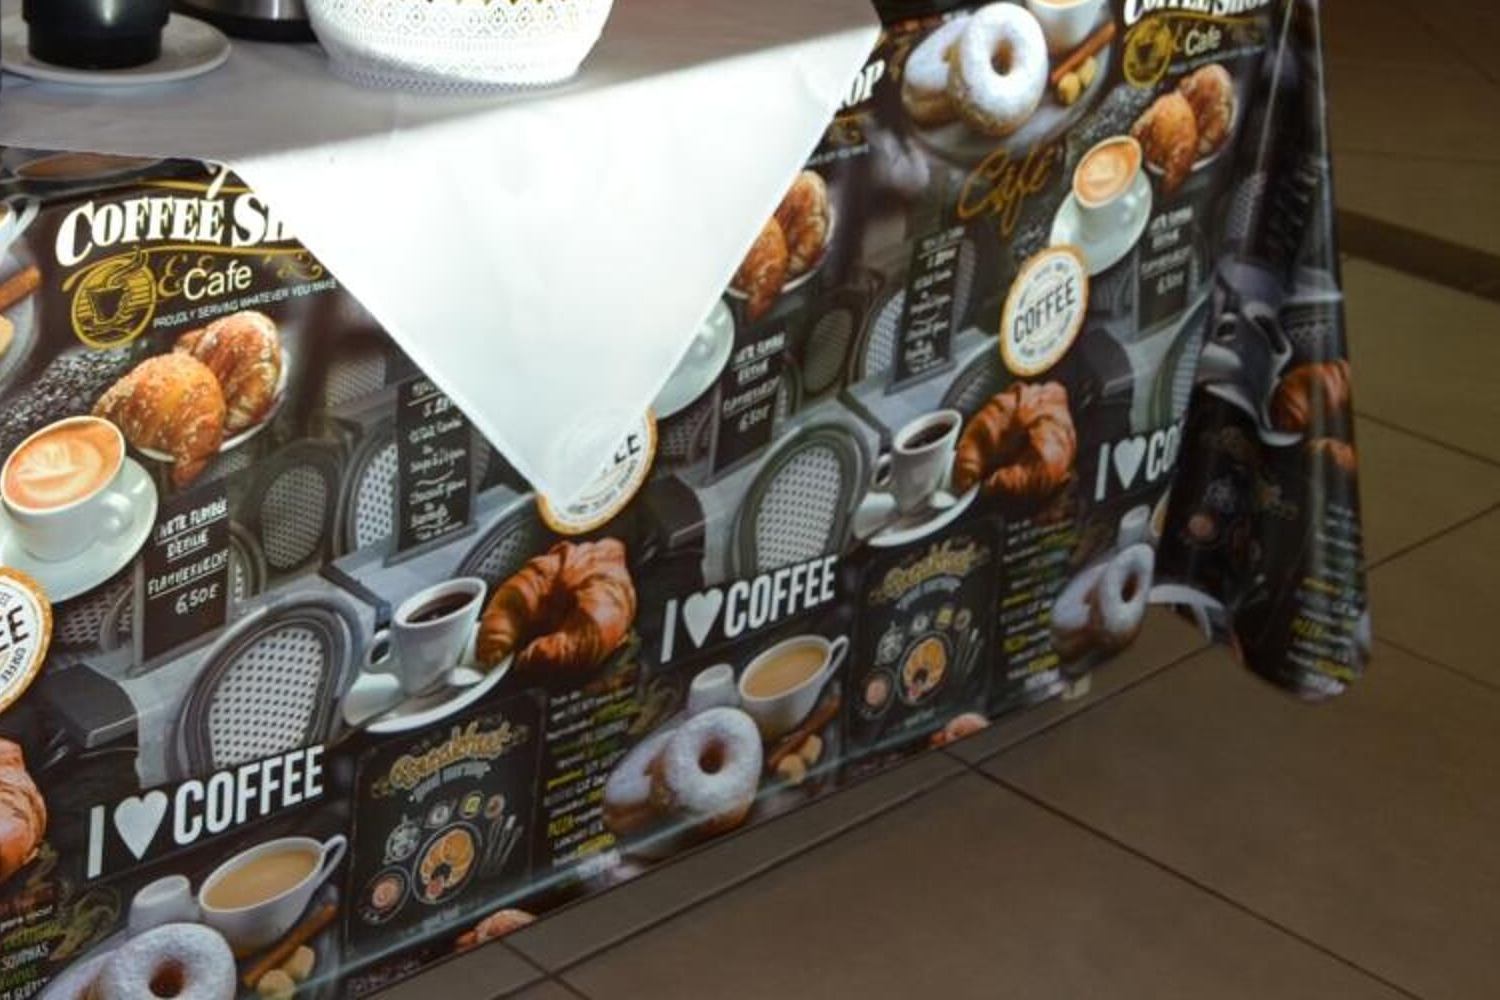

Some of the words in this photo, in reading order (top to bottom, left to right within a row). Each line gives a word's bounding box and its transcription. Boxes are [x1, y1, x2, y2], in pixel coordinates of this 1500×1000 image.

[55, 193, 226, 266] COFFEE
[182, 259, 252, 301] Cafe
[1013, 276, 1077, 345] COFFEE
[659, 599, 678, 664] I
[722, 554, 839, 639] COFFEE
[87, 804, 105, 881] I
[173, 743, 326, 846] COFFEE
